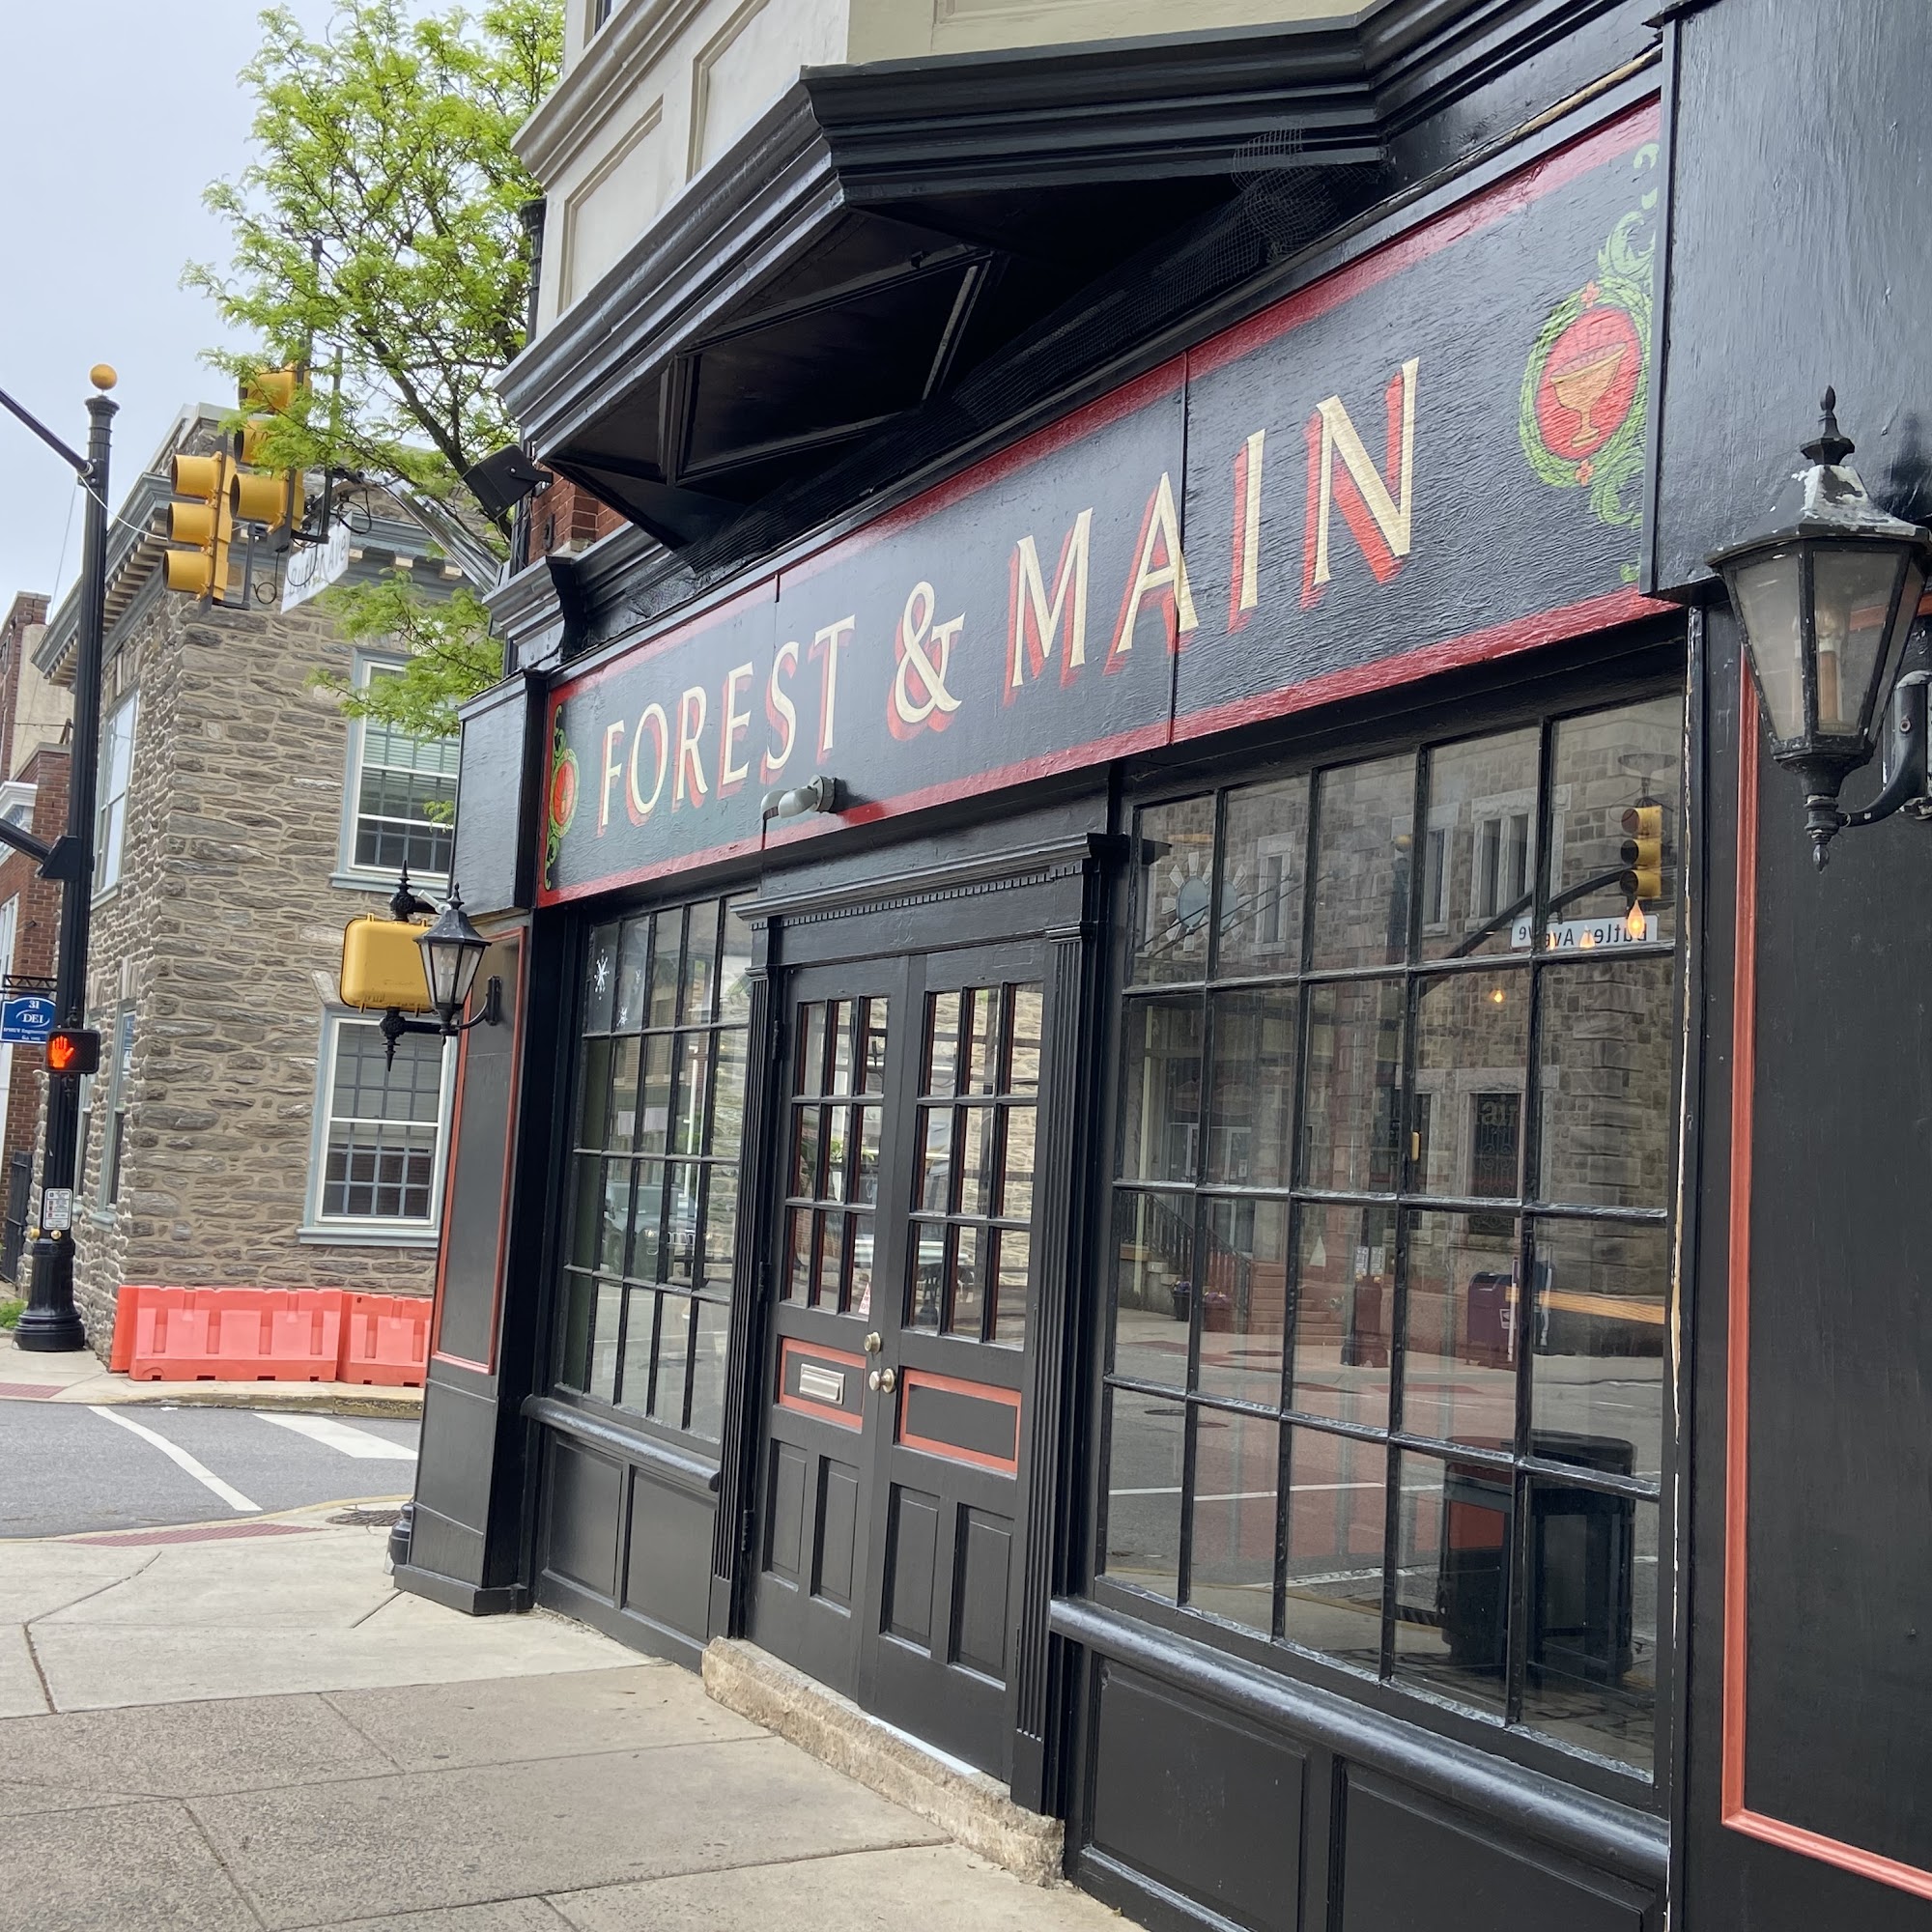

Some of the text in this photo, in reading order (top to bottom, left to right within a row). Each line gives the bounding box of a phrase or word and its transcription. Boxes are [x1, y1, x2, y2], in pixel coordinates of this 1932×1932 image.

[600, 355, 1420, 828] FOREST & MAIN
[28, 1000, 40, 1009] 31
[22, 1013, 44, 1024] DEI
